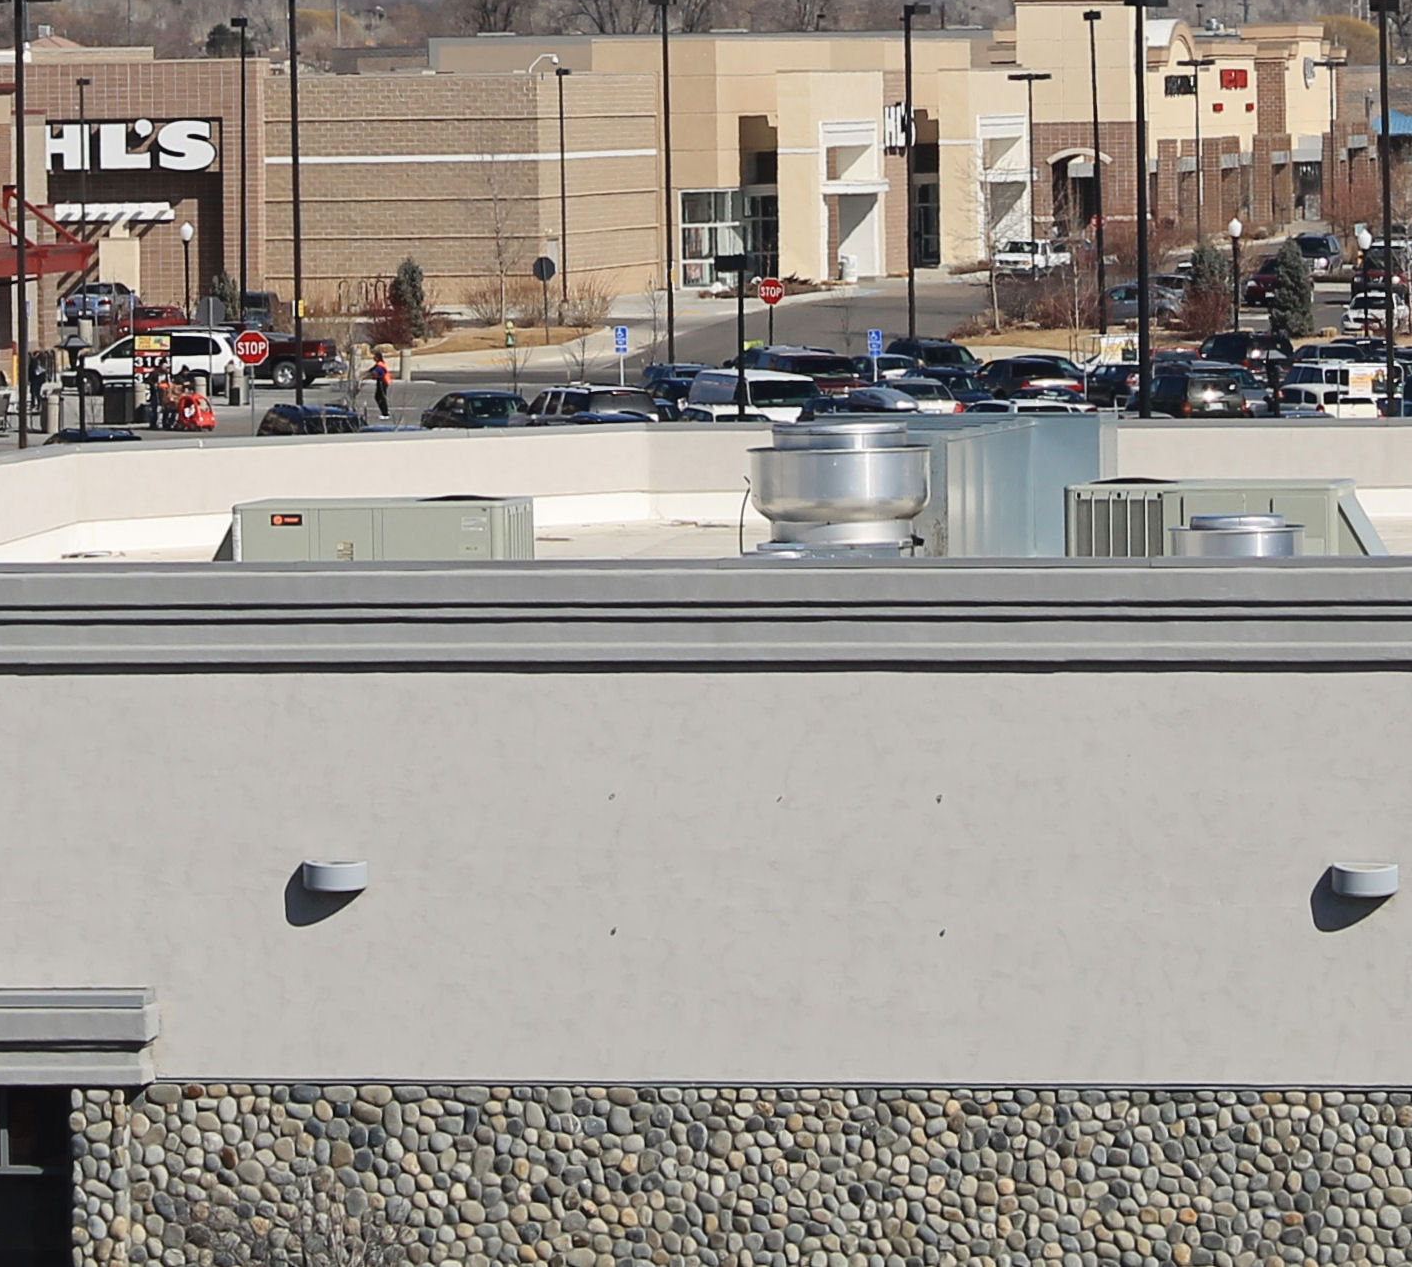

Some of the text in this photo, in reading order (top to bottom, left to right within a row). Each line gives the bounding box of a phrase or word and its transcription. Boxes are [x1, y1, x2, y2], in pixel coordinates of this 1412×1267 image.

[45, 119, 216, 171] HL'S
[760, 286, 782, 298] STOP
[237, 342, 266, 355] STOP
